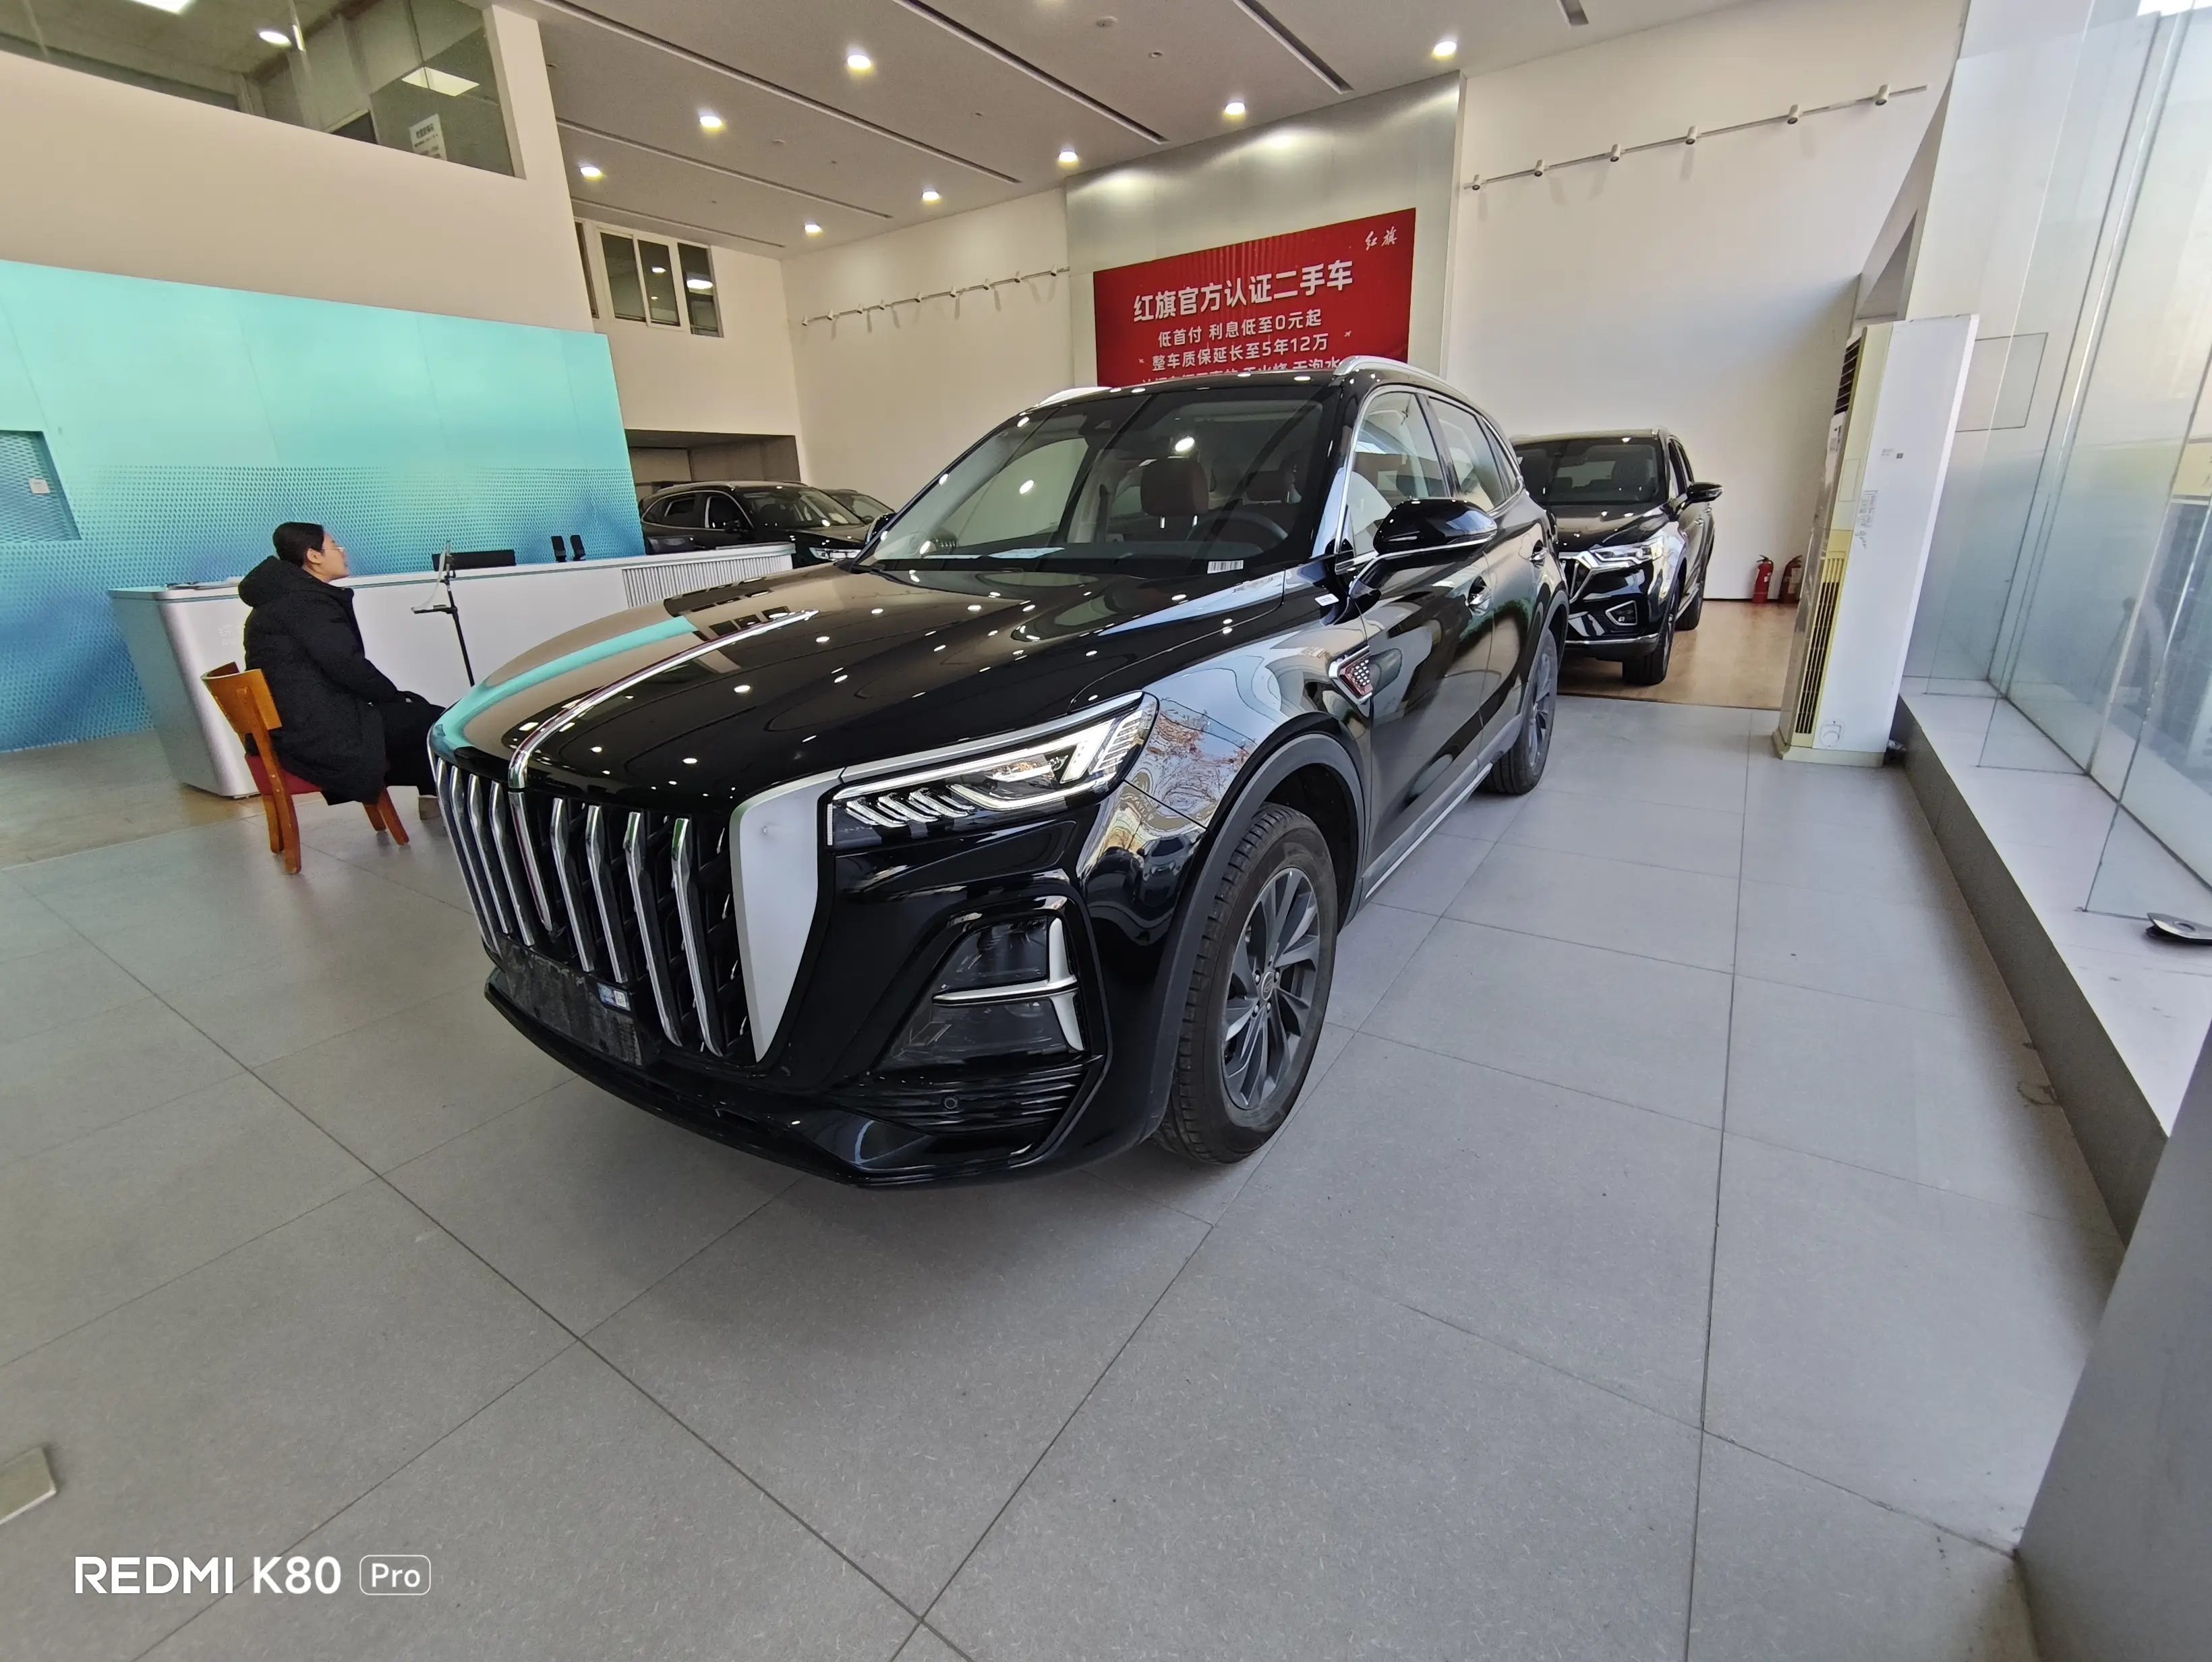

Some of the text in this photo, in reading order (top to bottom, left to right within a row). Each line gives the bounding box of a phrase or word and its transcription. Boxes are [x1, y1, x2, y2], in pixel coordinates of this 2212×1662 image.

[1134, 260, 1353, 322] 红旗官方认证二手车
[1158, 309, 1322, 348] 低首付 利息低至0元起
[1152, 333, 1329, 371] 整车质保延长至5年12万
